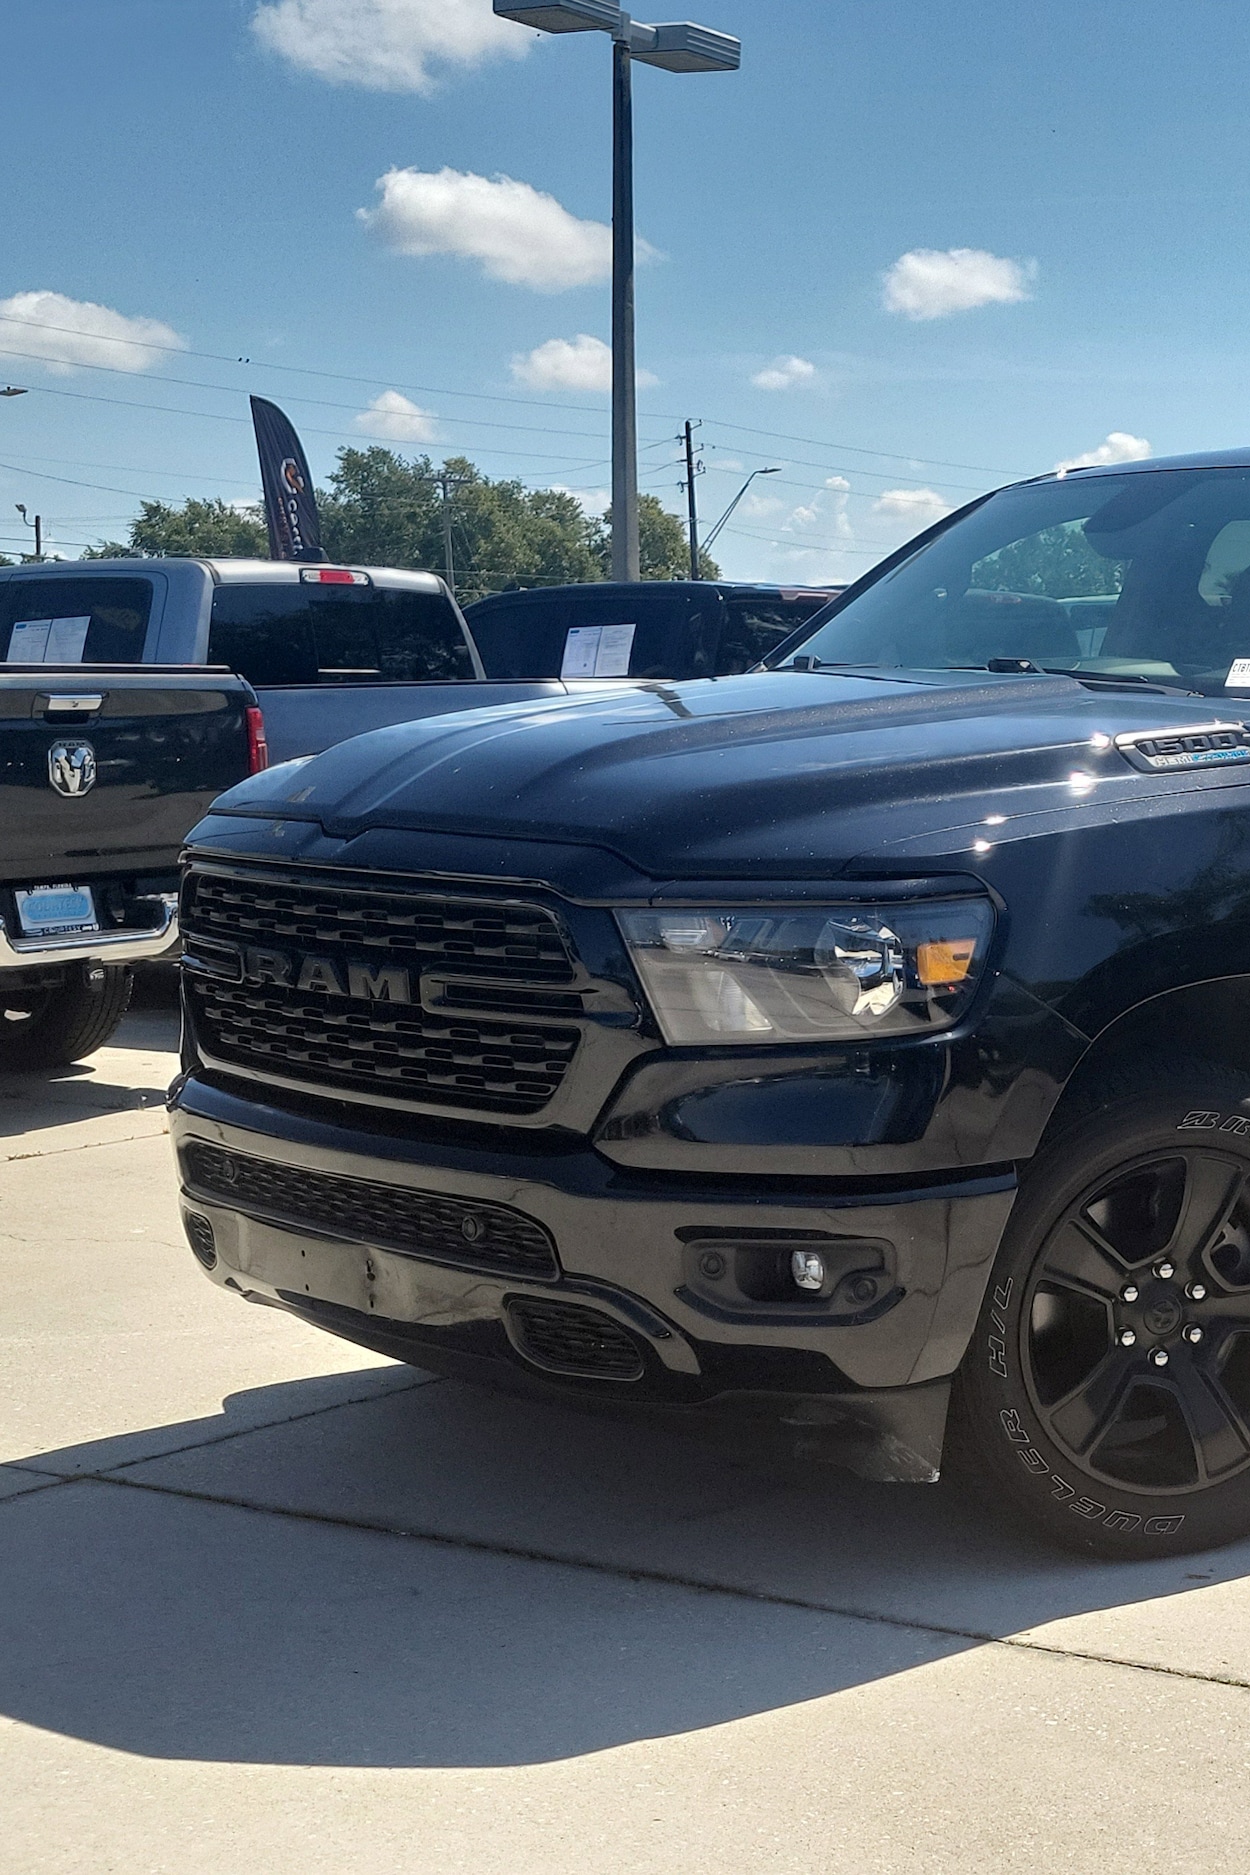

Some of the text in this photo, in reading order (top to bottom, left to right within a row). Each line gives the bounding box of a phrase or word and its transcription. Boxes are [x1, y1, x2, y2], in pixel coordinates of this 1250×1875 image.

[1136, 732, 1238, 756] 1500
[248, 951, 411, 1003] RAM
[988, 1277, 1186, 1535] DUELER H/L
